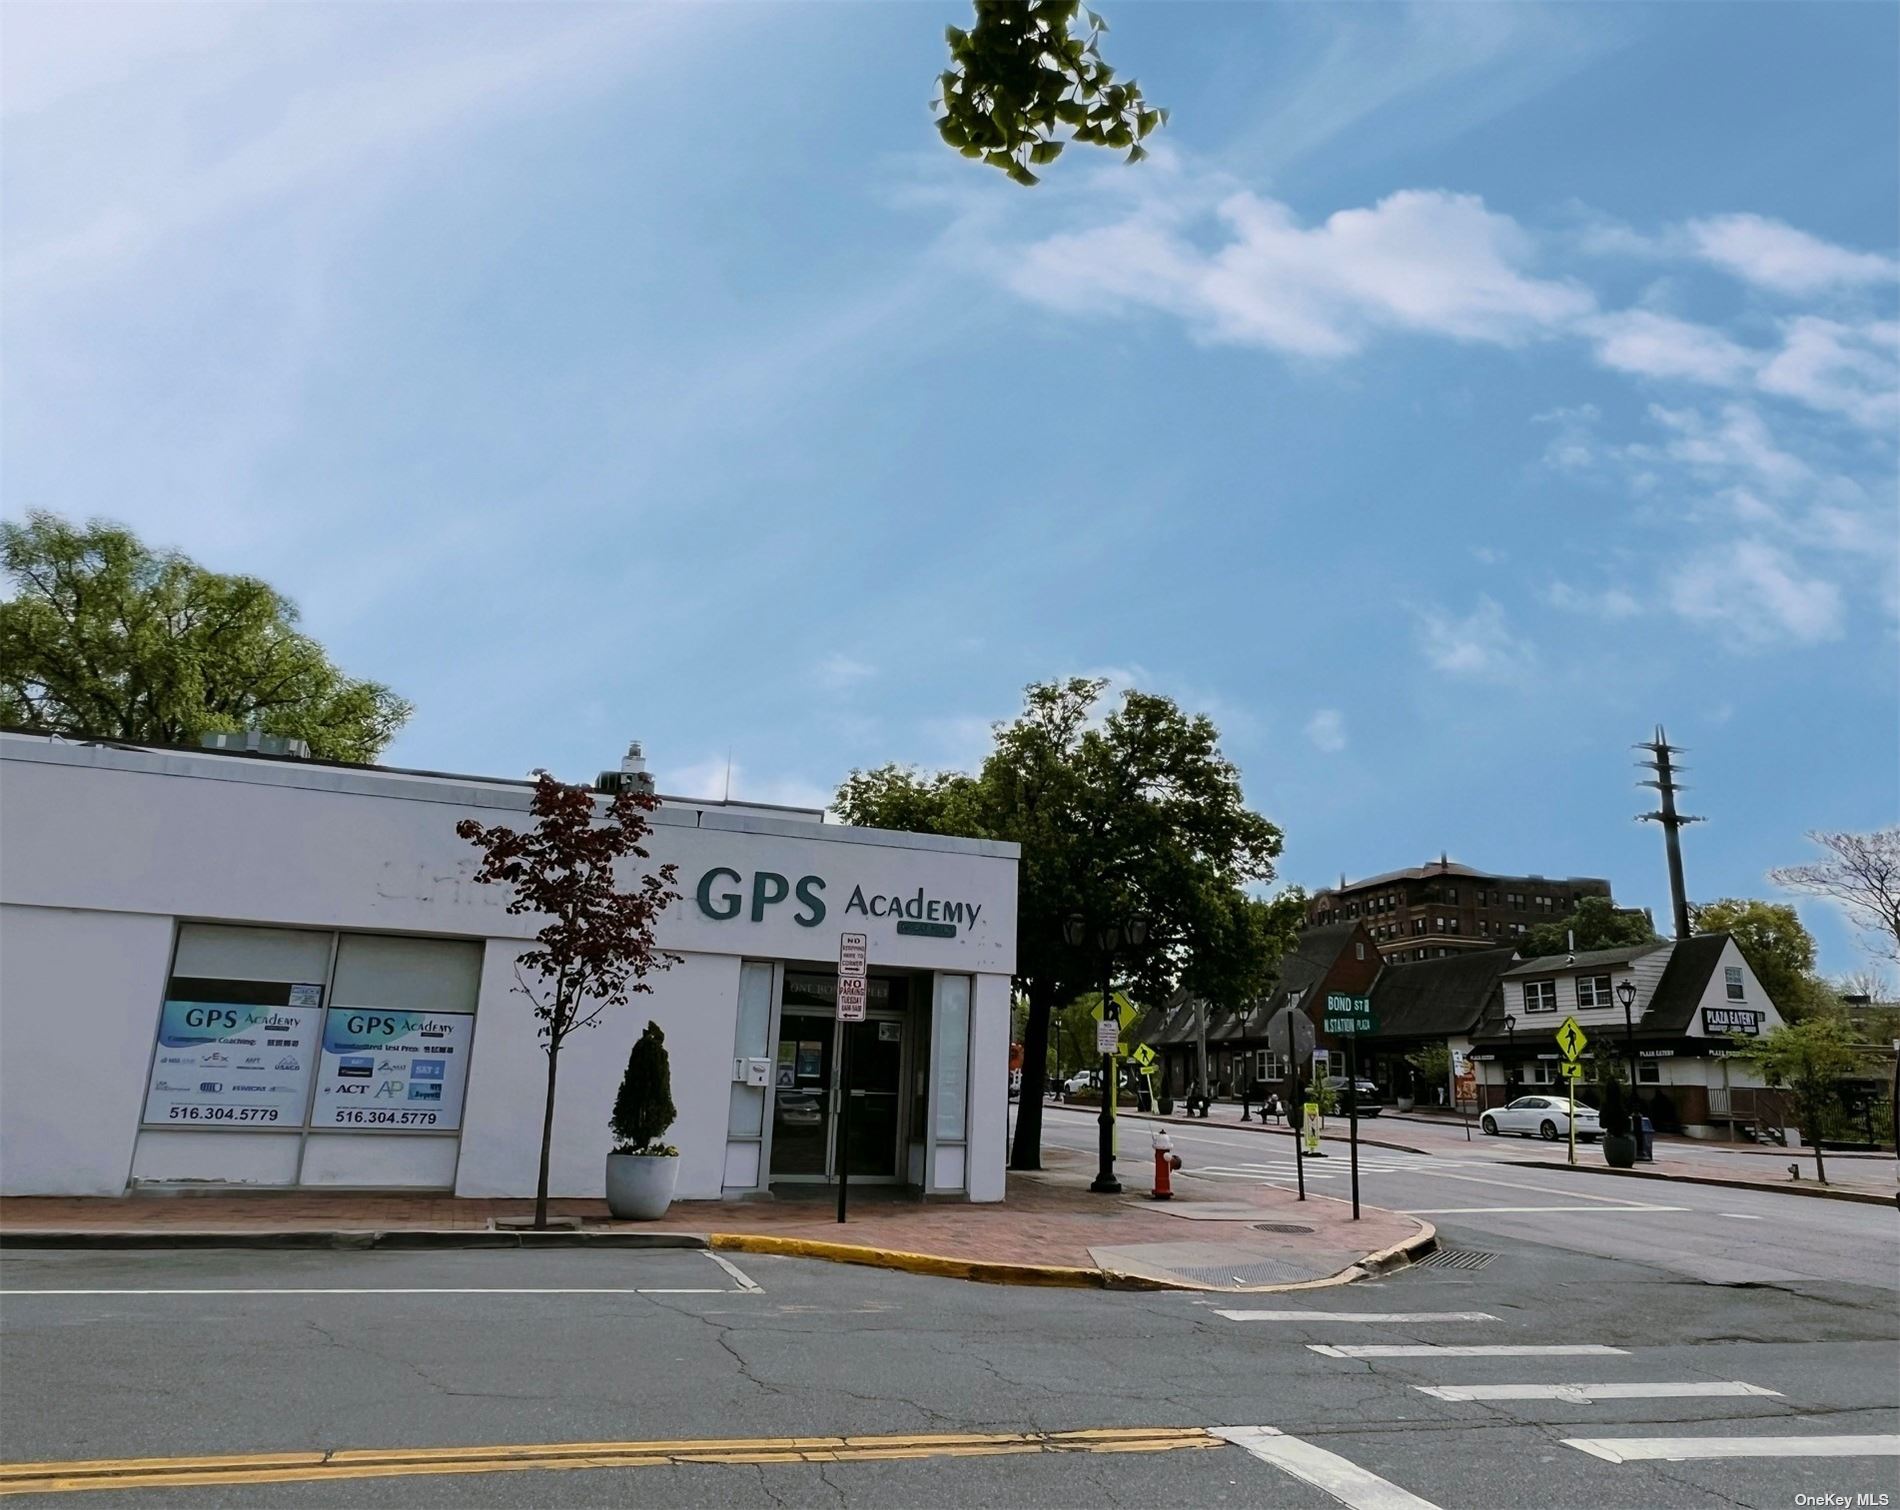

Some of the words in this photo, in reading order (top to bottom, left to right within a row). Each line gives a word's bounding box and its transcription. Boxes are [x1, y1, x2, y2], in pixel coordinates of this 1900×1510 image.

[697, 867, 827, 927] GPS
[840, 987, 865, 996] PARKING
[843, 980, 862, 988] NO
[1328, 996, 1352, 1011] BOND
[1354, 1000, 1363, 1011] ST
[186, 1008, 238, 1028] GPS
[347, 1015, 395, 1035] GPS
[1706, 1010, 1729, 1024] PLAZA
[1729, 1011, 1755, 1025] EATERY
[218, 1036, 256, 1046] Coaching
[335, 1084, 371, 1094] ACT
[374, 1080, 404, 1099] AP
[169, 1106, 279, 1121] 516.304.5779
[335, 1111, 437, 1124] 516.304.5779
